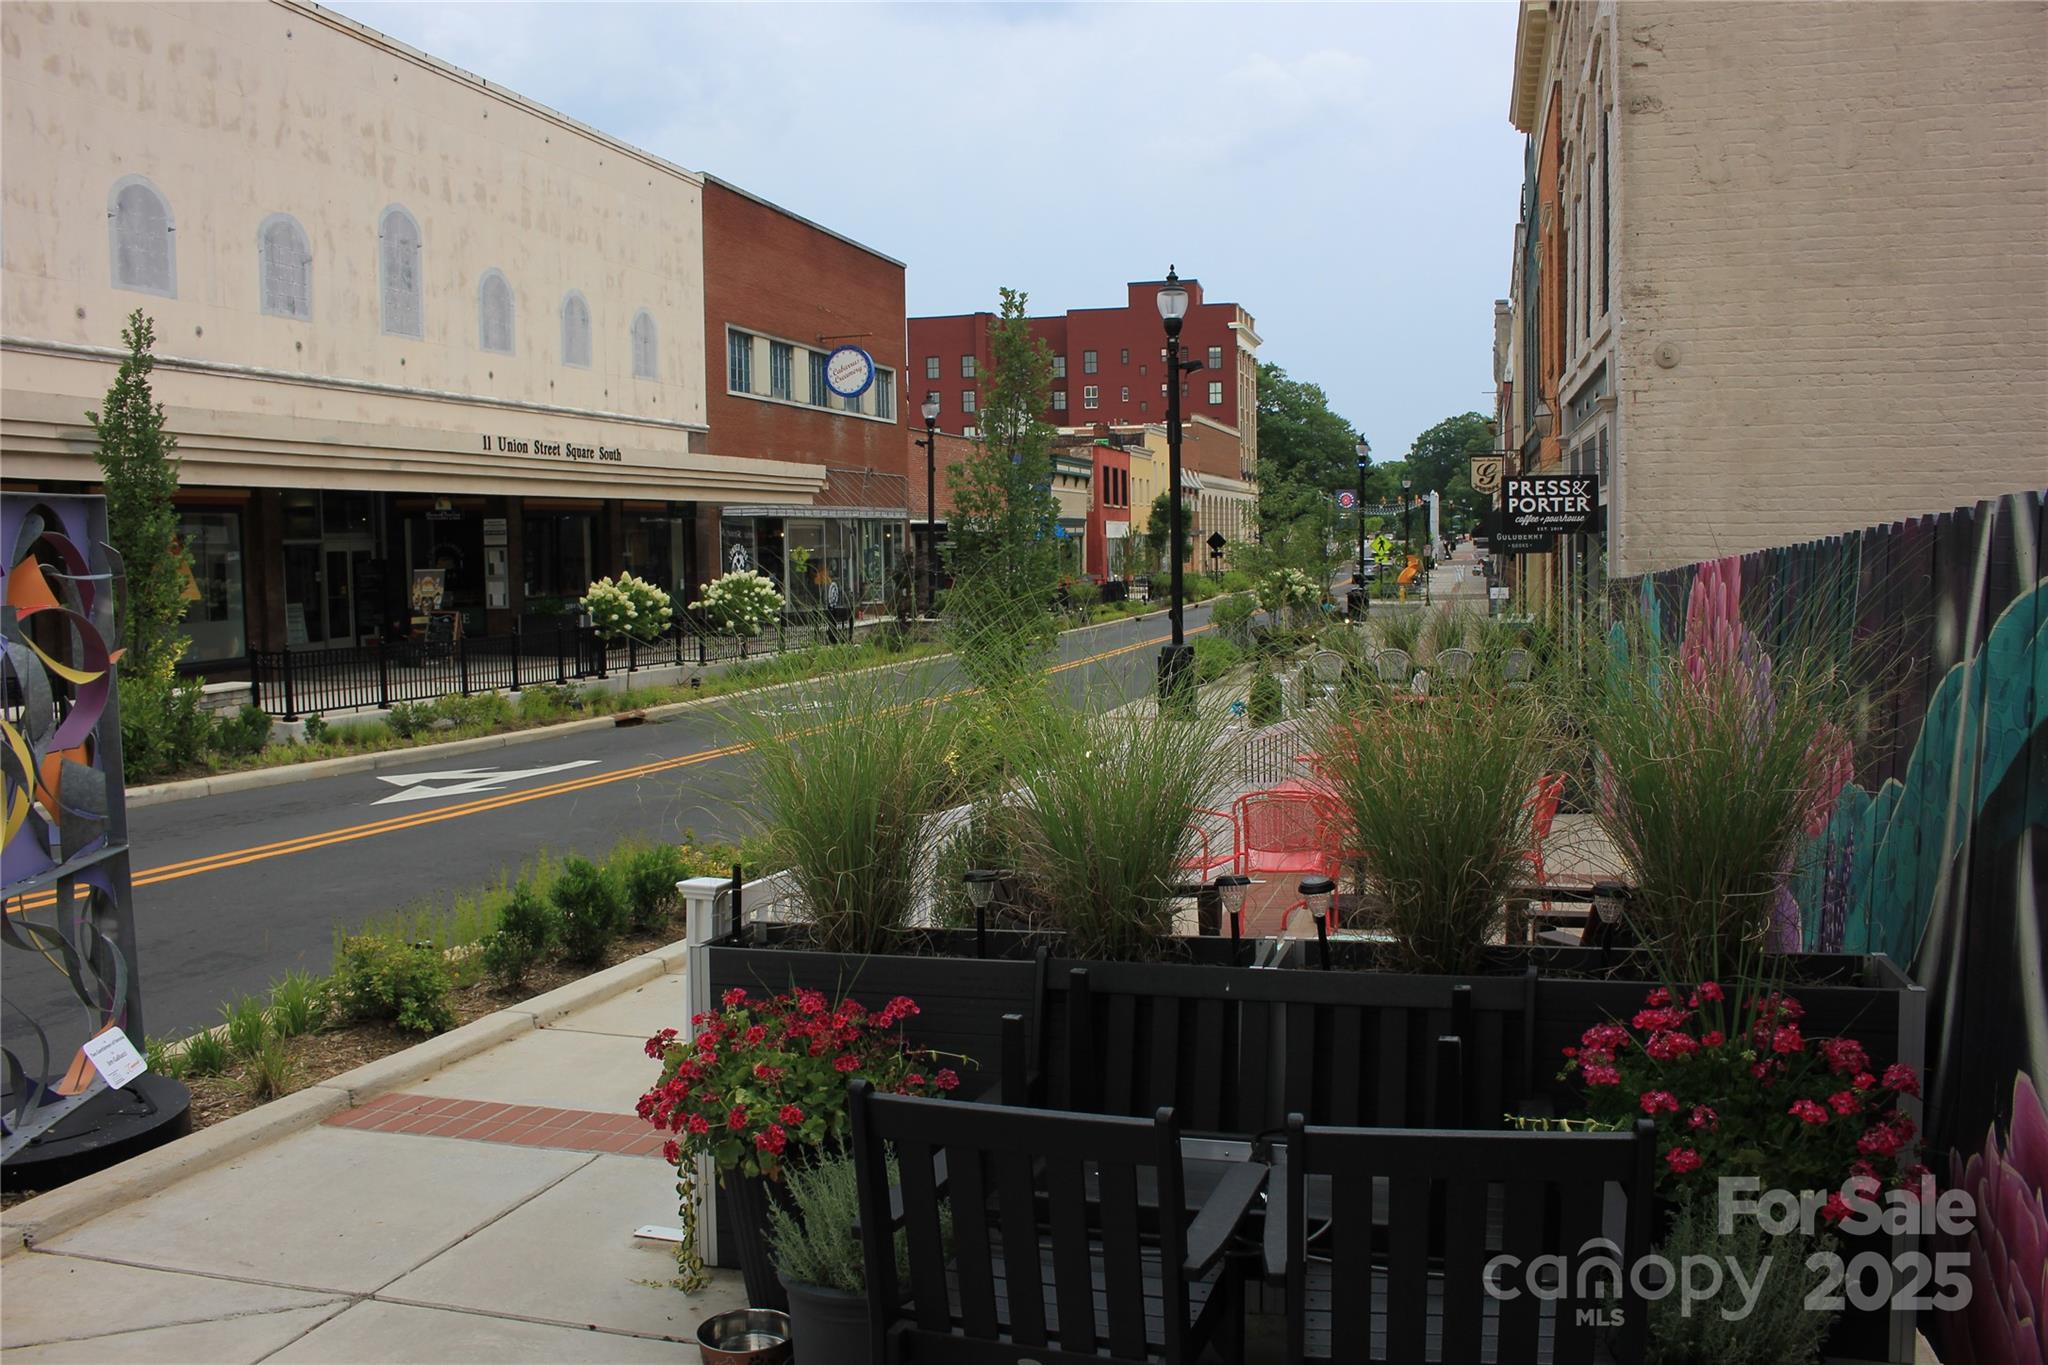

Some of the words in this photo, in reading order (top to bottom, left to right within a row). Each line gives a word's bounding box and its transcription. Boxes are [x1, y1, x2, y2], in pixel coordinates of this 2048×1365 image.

[483, 435, 492, 450] 11
[498, 436, 529, 453] Union
[534, 439, 561, 456] Street
[566, 443, 595, 460] Square
[599, 446, 622, 461] South
[1508, 497, 1591, 513] PORTER
[1514, 514, 1539, 526] coffee
[1543, 513, 1585, 525] pourhouse
